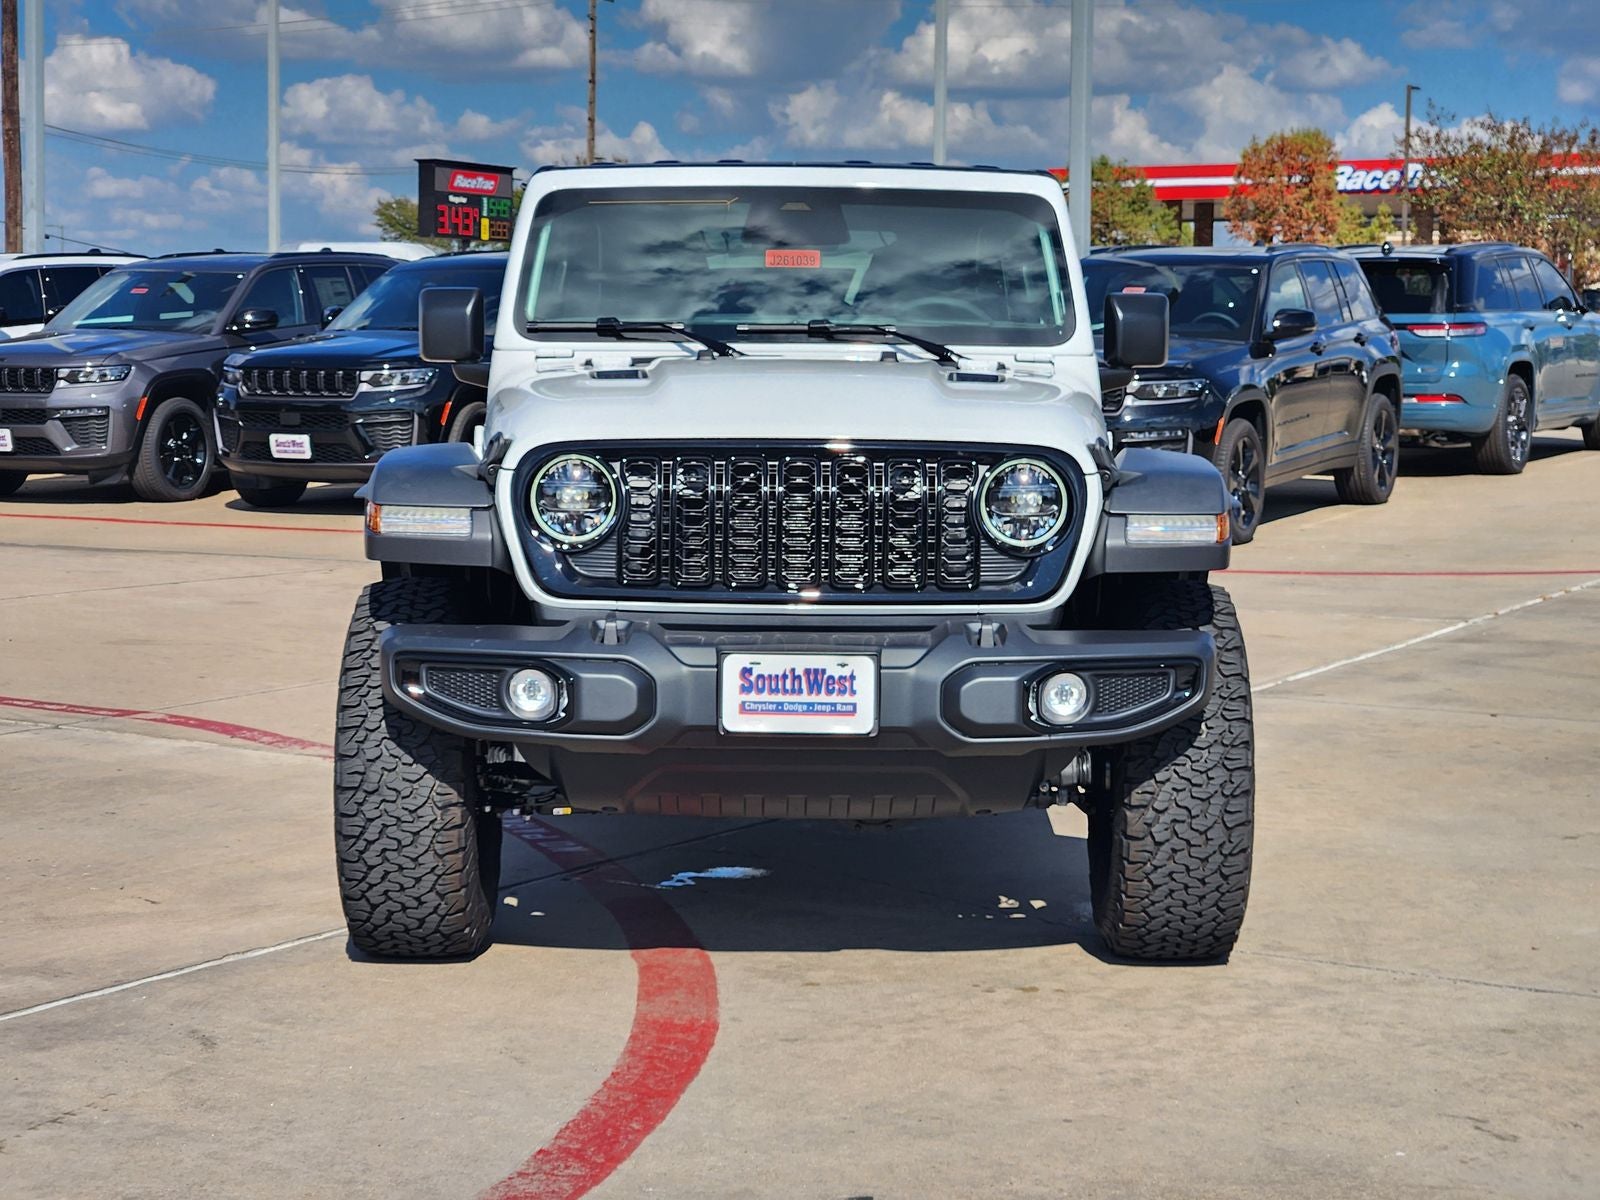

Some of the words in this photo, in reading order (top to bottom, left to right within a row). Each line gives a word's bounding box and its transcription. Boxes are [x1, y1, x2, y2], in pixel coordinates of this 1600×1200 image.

[453, 174, 496, 191] RaceTrac
[769, 255, 816, 266] J261039
[739, 666, 857, 697] SouthWest
[744, 702, 777, 711] Chrysler
[783, 703, 808, 712] Dodge
[813, 704, 831, 713] Jeep
[836, 704, 853, 712] Ram
